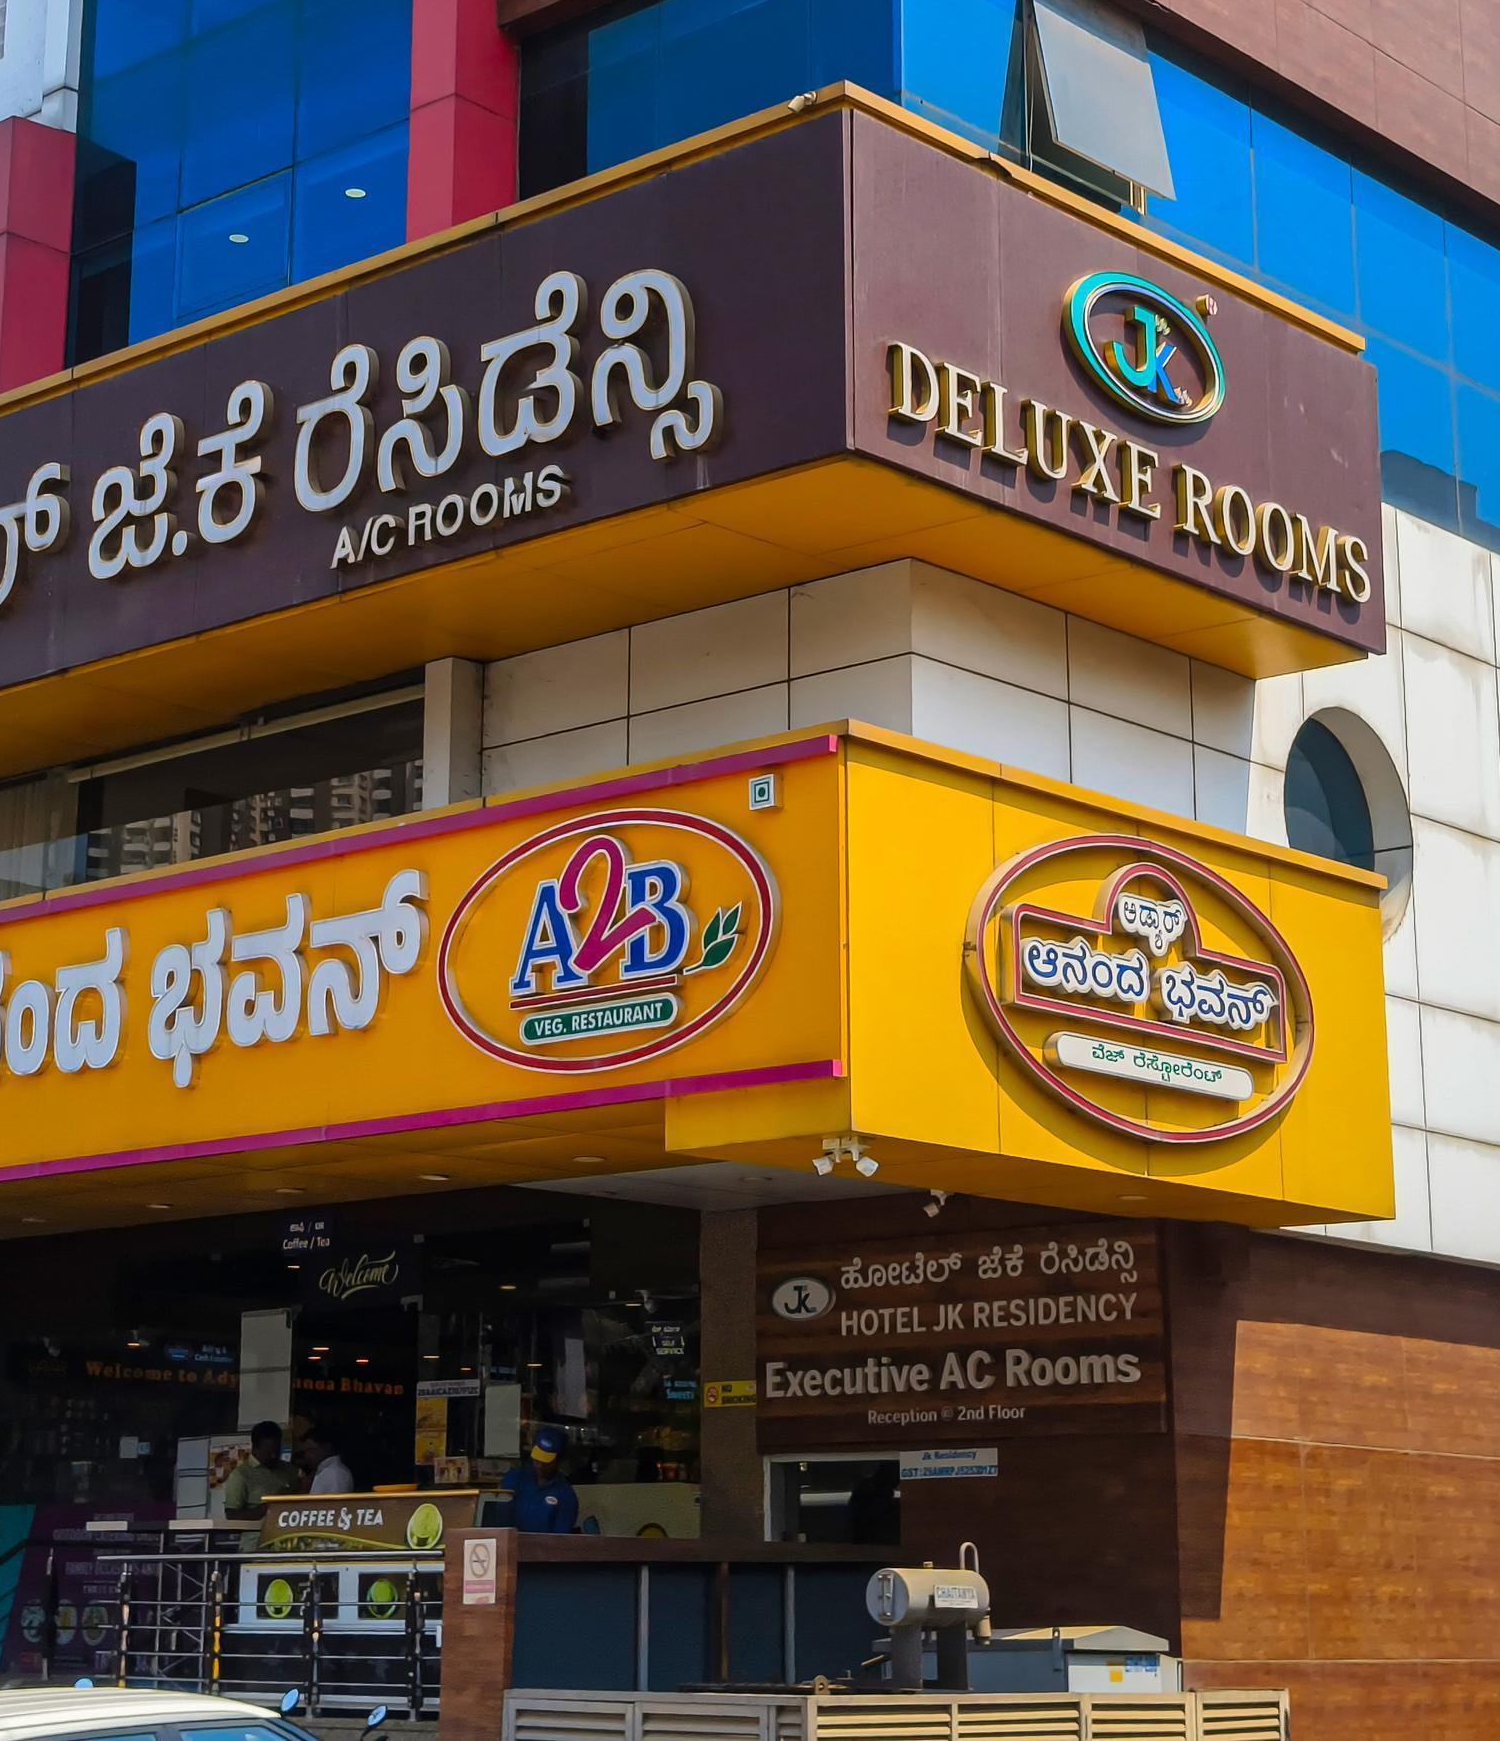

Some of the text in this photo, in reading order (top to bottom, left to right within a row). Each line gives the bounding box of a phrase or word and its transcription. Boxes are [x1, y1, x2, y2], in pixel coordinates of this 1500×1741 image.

[295, 269, 723, 512] ರೆಸಿಡೆನ್ಸಿ
[888, 342, 1371, 603] DELUXE ROOMS
[331, 463, 572, 570] A/C ROOMS
[509, 835, 693, 996] A2B
[148, 868, 431, 1088] ಭವನ್
[1026, 939, 1276, 1027] ಆನಂದ ಭವನ್
[534, 1002, 664, 1037] VEG. RESTAURANT
[282, 1238, 308, 1249] Coffee
[319, 1251, 398, 1298] Welcome
[841, 1252, 962, 1289] ಹೋಟೆಲ್
[840, 1292, 1138, 1337] HOTEL JK RESIDENCY
[86, 1361, 172, 1381] Welcome
[178, 1368, 197, 1383] to
[340, 1377, 404, 1396] Bhavan
[765, 1348, 1141, 1398] Executive AC Rooms
[867, 1407, 938, 1427] Reception
[957, 1405, 985, 1421] 2nd
[988, 1404, 1026, 1420] Floor
[278, 1510, 334, 1528] COFFEE
[356, 1509, 384, 1526] TEA
